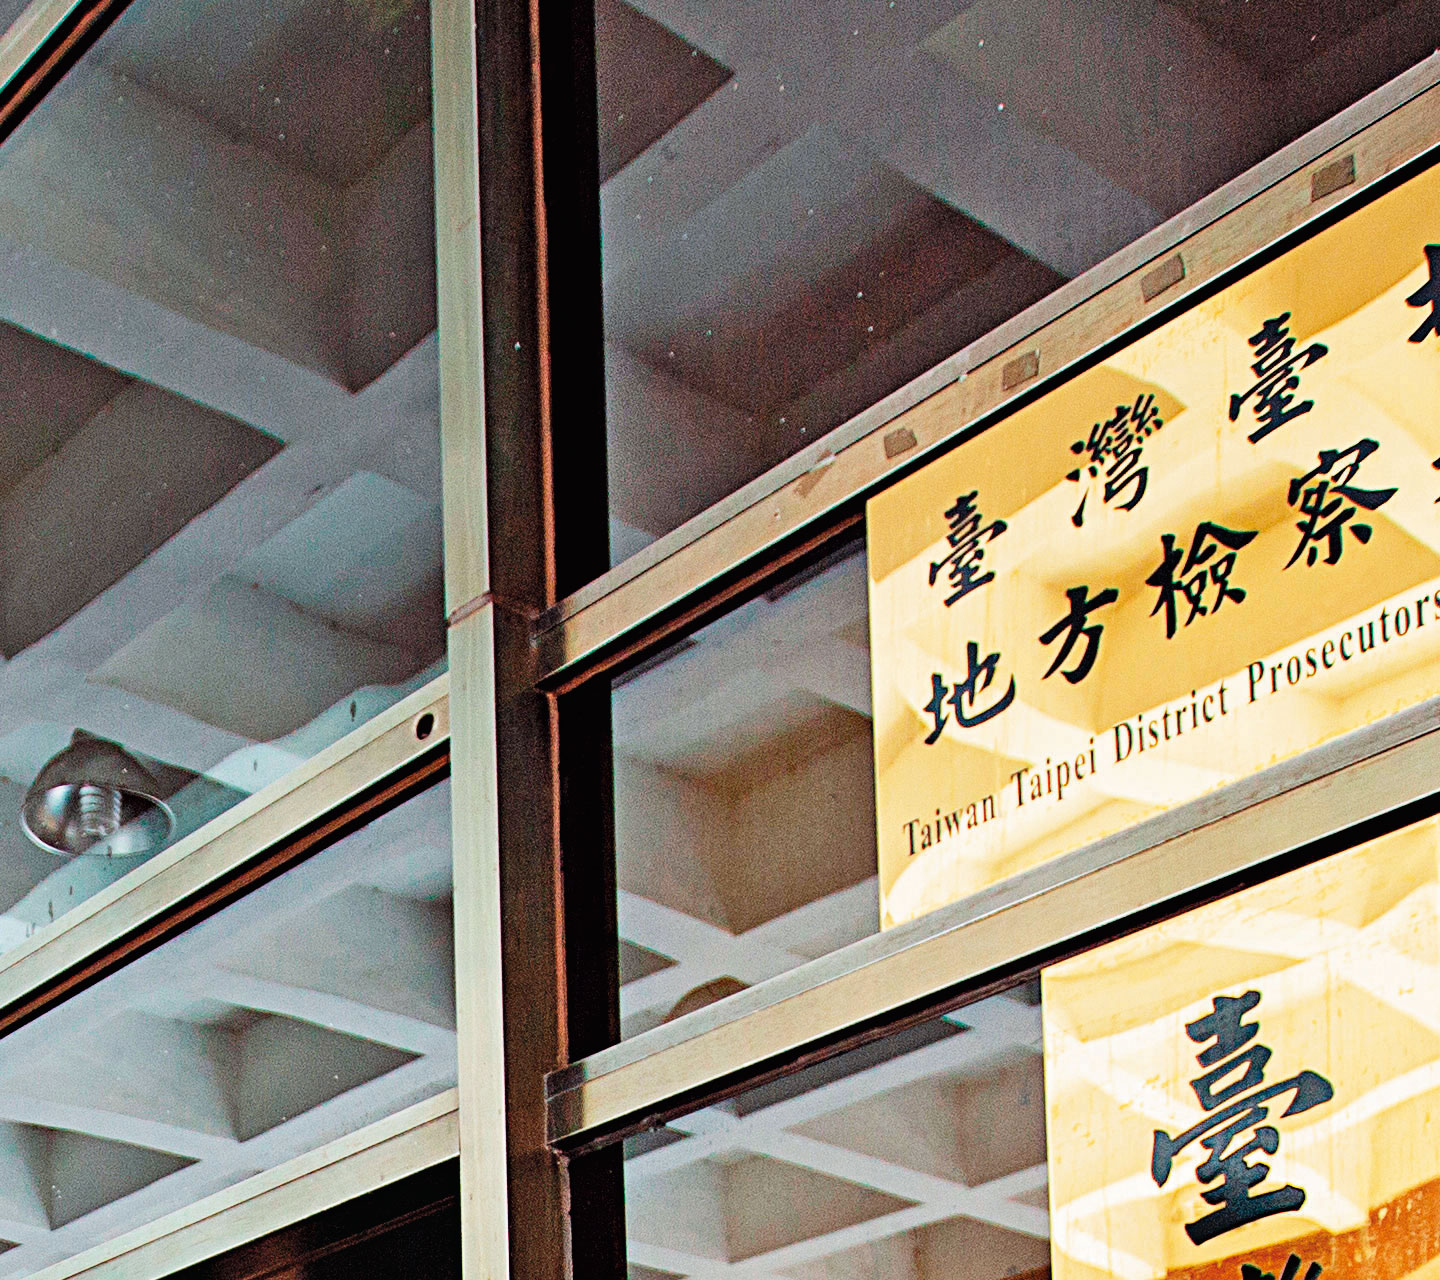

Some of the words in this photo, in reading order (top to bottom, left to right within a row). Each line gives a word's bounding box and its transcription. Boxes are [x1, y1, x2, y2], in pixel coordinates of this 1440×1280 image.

[903, 793, 996, 857] Taiwan
[1011, 737, 1097, 808] Taipei
[1113, 678, 1228, 763] District
